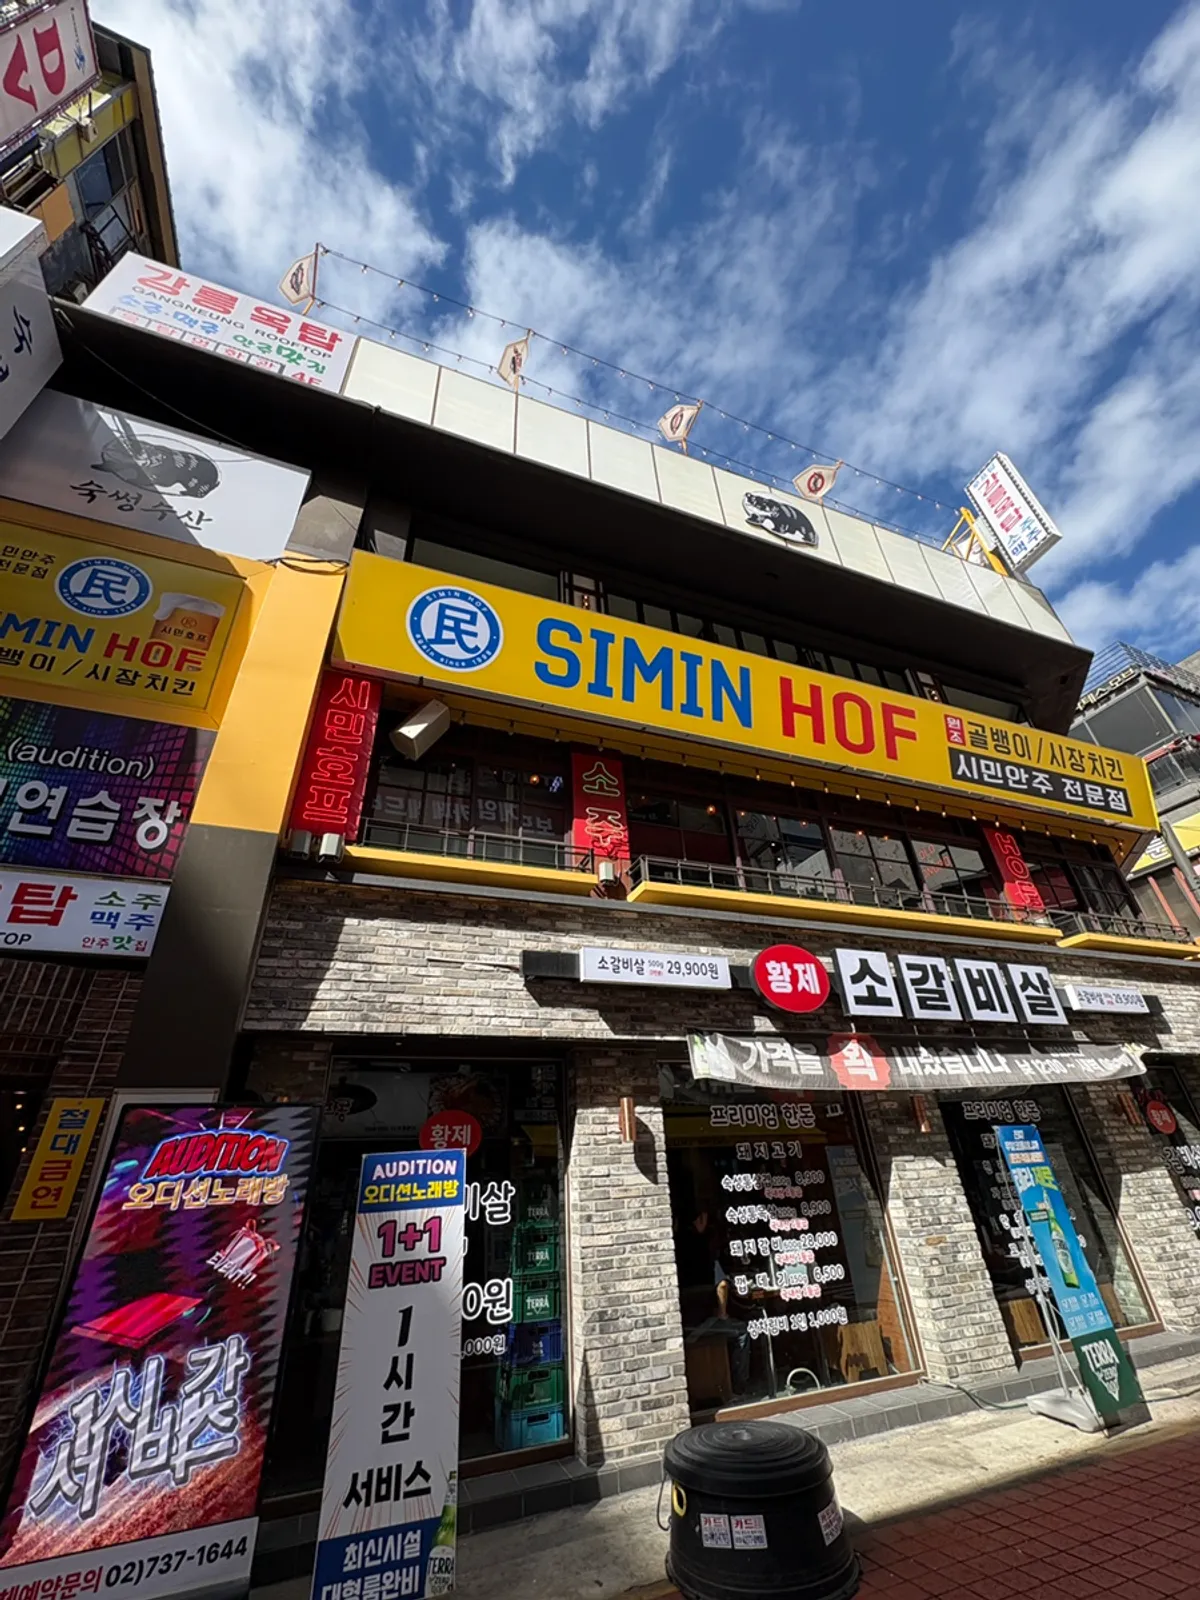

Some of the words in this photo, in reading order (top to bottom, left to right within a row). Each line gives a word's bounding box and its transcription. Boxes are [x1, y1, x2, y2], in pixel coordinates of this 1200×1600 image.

[132, 286, 245, 330] GANGNEUNG
[254, 328, 332, 360] ROOFTOP
[0, 612, 95, 653] MIN
[103, 632, 207, 672] HOF
[426, 602, 481, 656] 民
[534, 617, 753, 729] SIMIN
[779, 676, 919, 761] HOF
[8, 736, 155, 780] (audition)
[303, 677, 371, 824] 시민호프
[582, 761, 625, 847] 소주
[956, 753, 1054, 795] 시민안주
[1061, 777, 1128, 813] 전문점
[0, 778, 182, 850] 연습장
[90, 910, 156, 931] 맥주
[94, 890, 163, 911] 소주
[82, 935, 149, 952] 안주맛집
[597, 955, 645, 976] 소갈비살
[666, 960, 719, 980] 29,900원
[765, 959, 822, 995] 황제
[849, 957, 1060, 1018] 소갈비살
[739, 1040, 824, 1076] 가격을
[710, 1103, 780, 1130] 프리미엄
[780, 1102, 816, 1129] 한돈
[142, 1132, 288, 1180] AUDITION
[372, 1158, 458, 1180] AUDITION
[121, 1173, 291, 1212] 오디션노래방
[362, 1179, 460, 1205] 오디션노래방
[376, 1215, 444, 1259] 1+1
[367, 1255, 447, 1290] EVENT
[813, 1263, 845, 1284] 6,500
[525, 1295, 550, 1310] TERRA
[342, 1460, 432, 1510] 서비스
[104, 1535, 249, 1588] 02)737-1644
[342, 1529, 421, 1573] 최신시설
